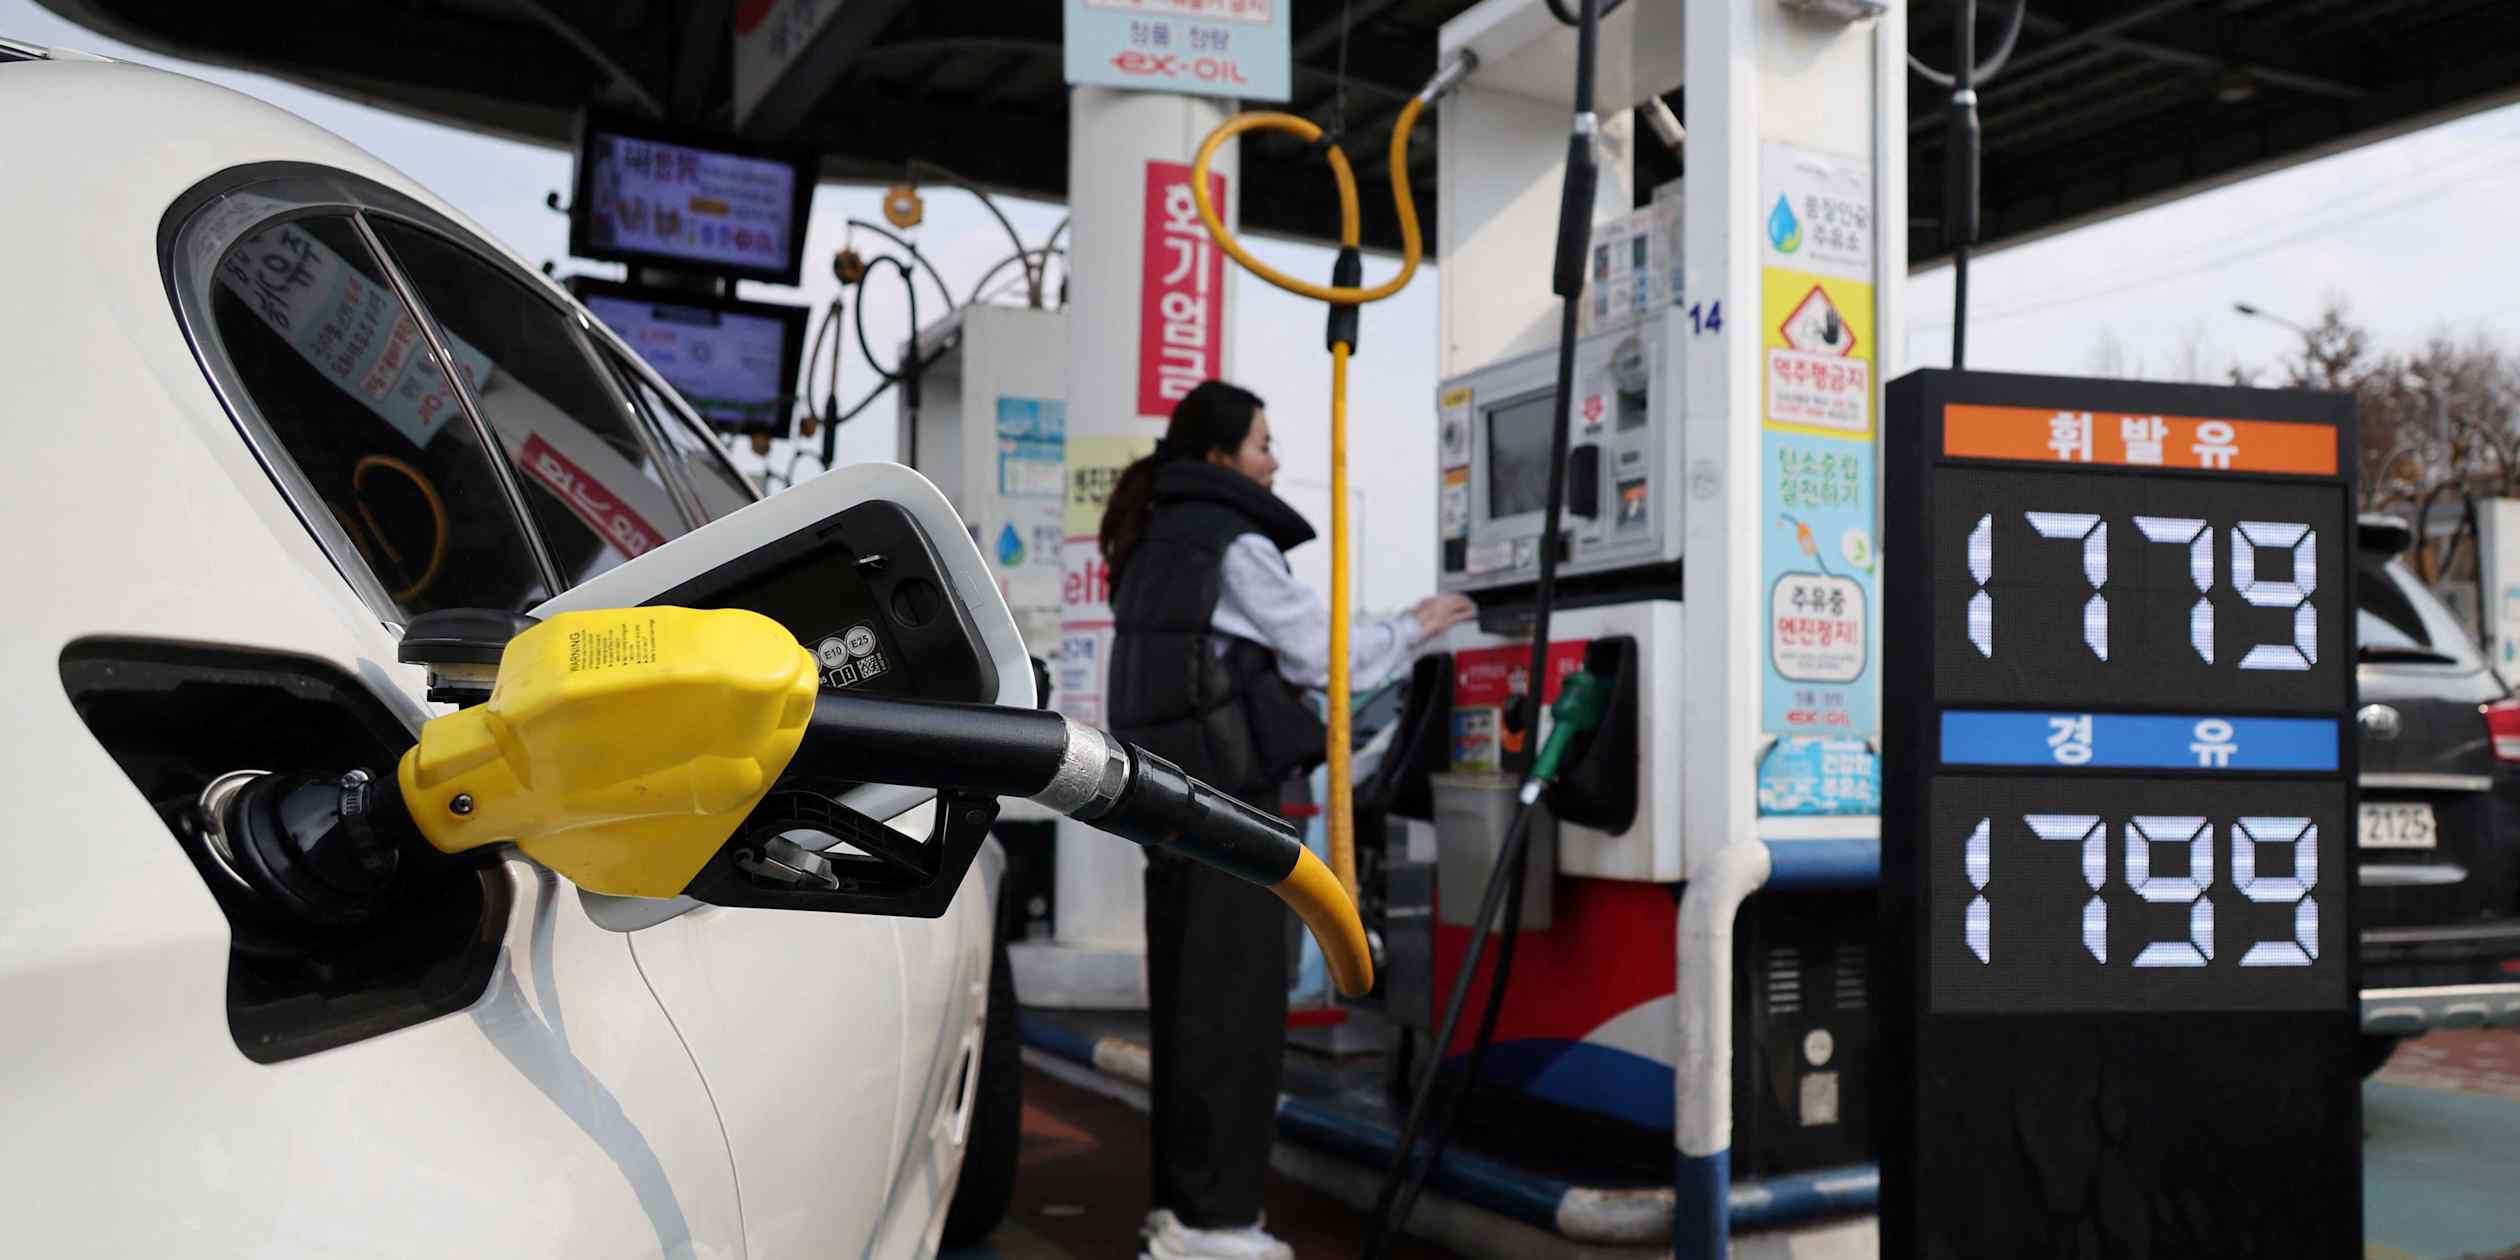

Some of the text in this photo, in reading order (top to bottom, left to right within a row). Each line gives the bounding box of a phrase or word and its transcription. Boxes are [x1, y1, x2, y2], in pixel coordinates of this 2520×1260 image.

[1689, 302, 1723, 335] 14
[2047, 411, 2240, 469] 휘발유
[1966, 511, 2317, 670] 1779
[569, 632, 581, 672] WARNING
[824, 646, 842, 660] E10
[850, 635, 869, 649] E25
[2366, 807, 2429, 840] 2125
[1964, 814, 2319, 968] 1799
